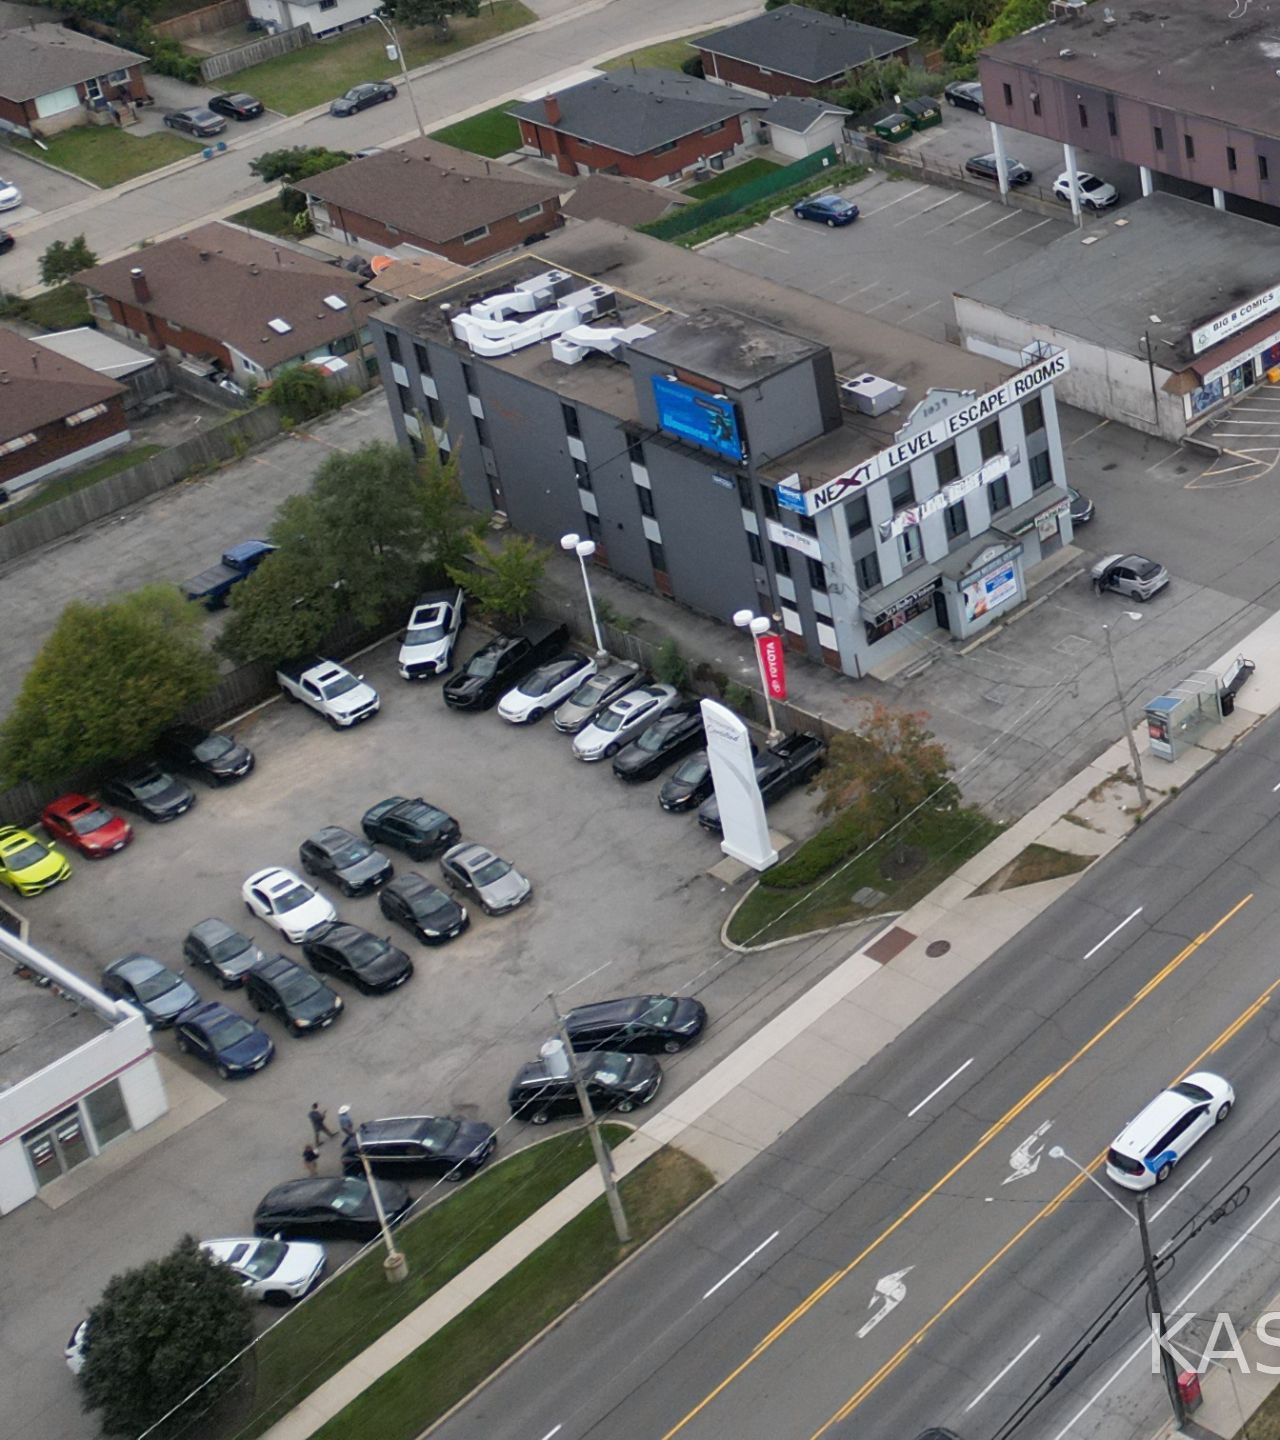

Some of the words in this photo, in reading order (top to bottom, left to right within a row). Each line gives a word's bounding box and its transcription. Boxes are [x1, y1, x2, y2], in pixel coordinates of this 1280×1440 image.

[1212, 314, 1229, 332] BIG
[1231, 312, 1237, 322] B
[1240, 292, 1274, 317] COMICS
[814, 464, 872, 509] NEXT
[888, 431, 938, 467] LEVEL
[949, 389, 1008, 433] ESCAPE
[1014, 356, 1066, 397] ROOMS
[766, 641, 778, 679] TOYOTA
